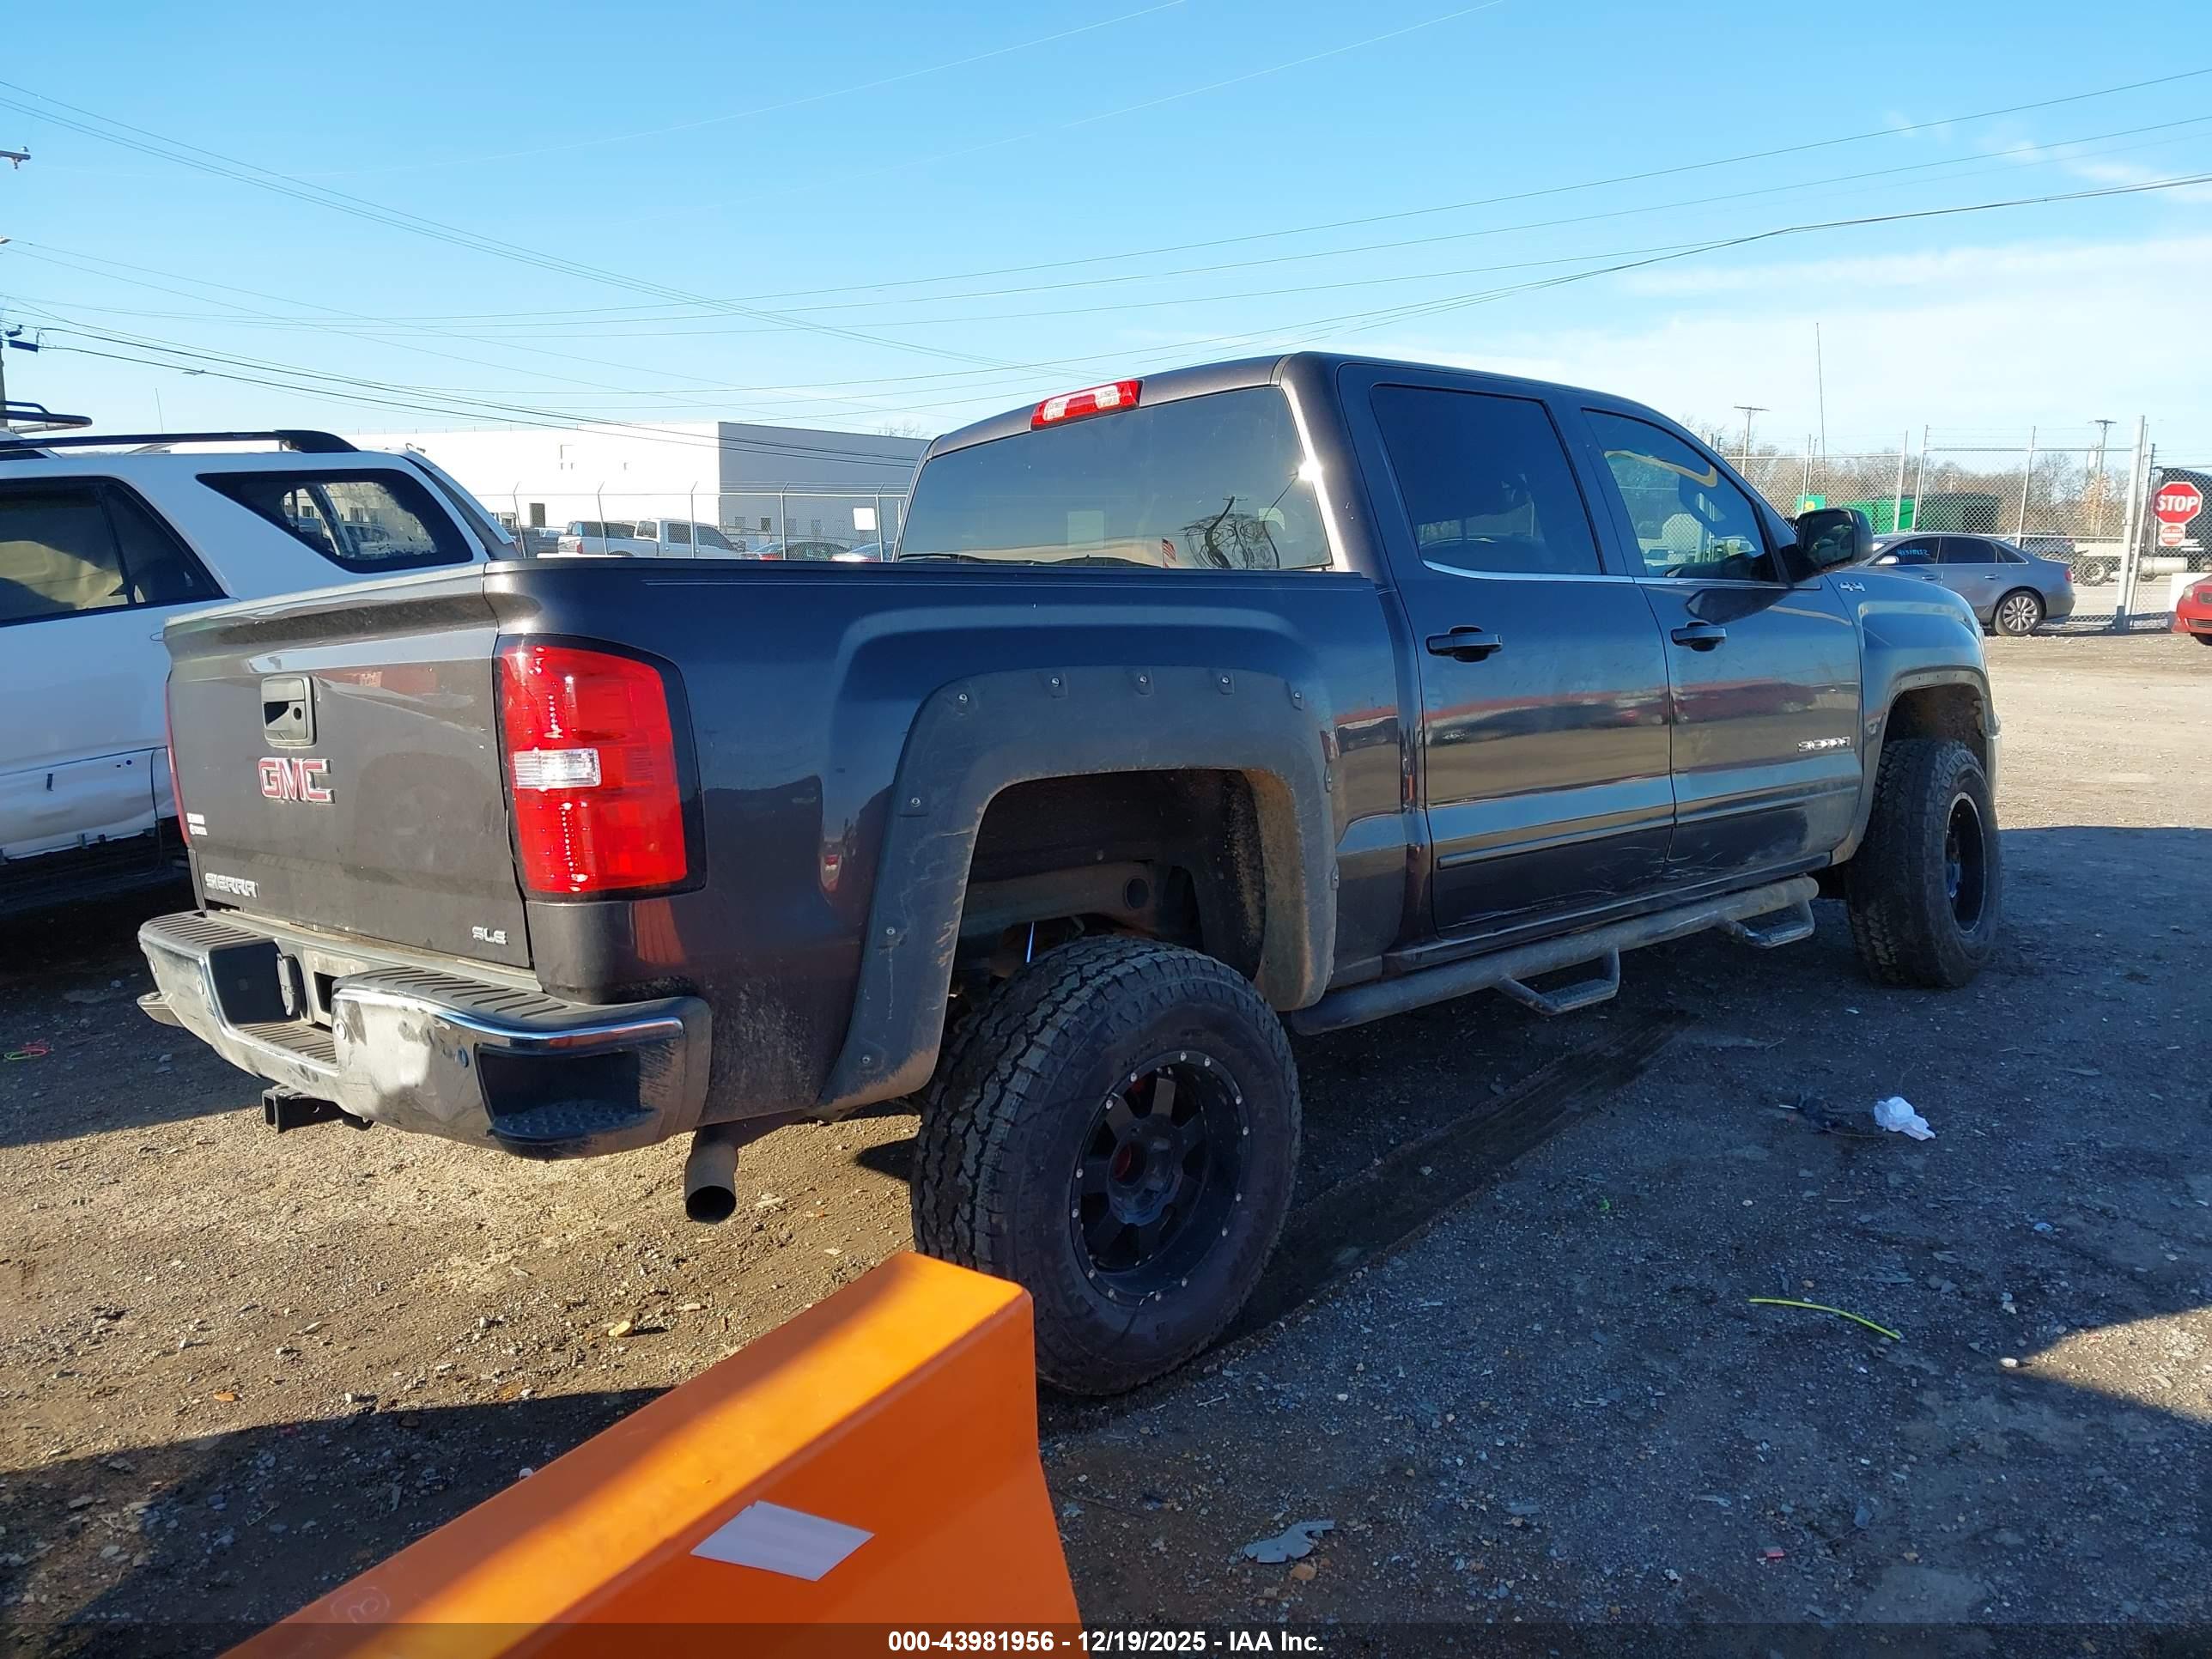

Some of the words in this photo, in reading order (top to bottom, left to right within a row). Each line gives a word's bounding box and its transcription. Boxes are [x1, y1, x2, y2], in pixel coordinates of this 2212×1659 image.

[2156, 494, 2199, 513] STOP
[258, 757, 336, 805] GMC
[205, 872, 260, 899] SIERRA
[472, 926, 507, 945] SLE
